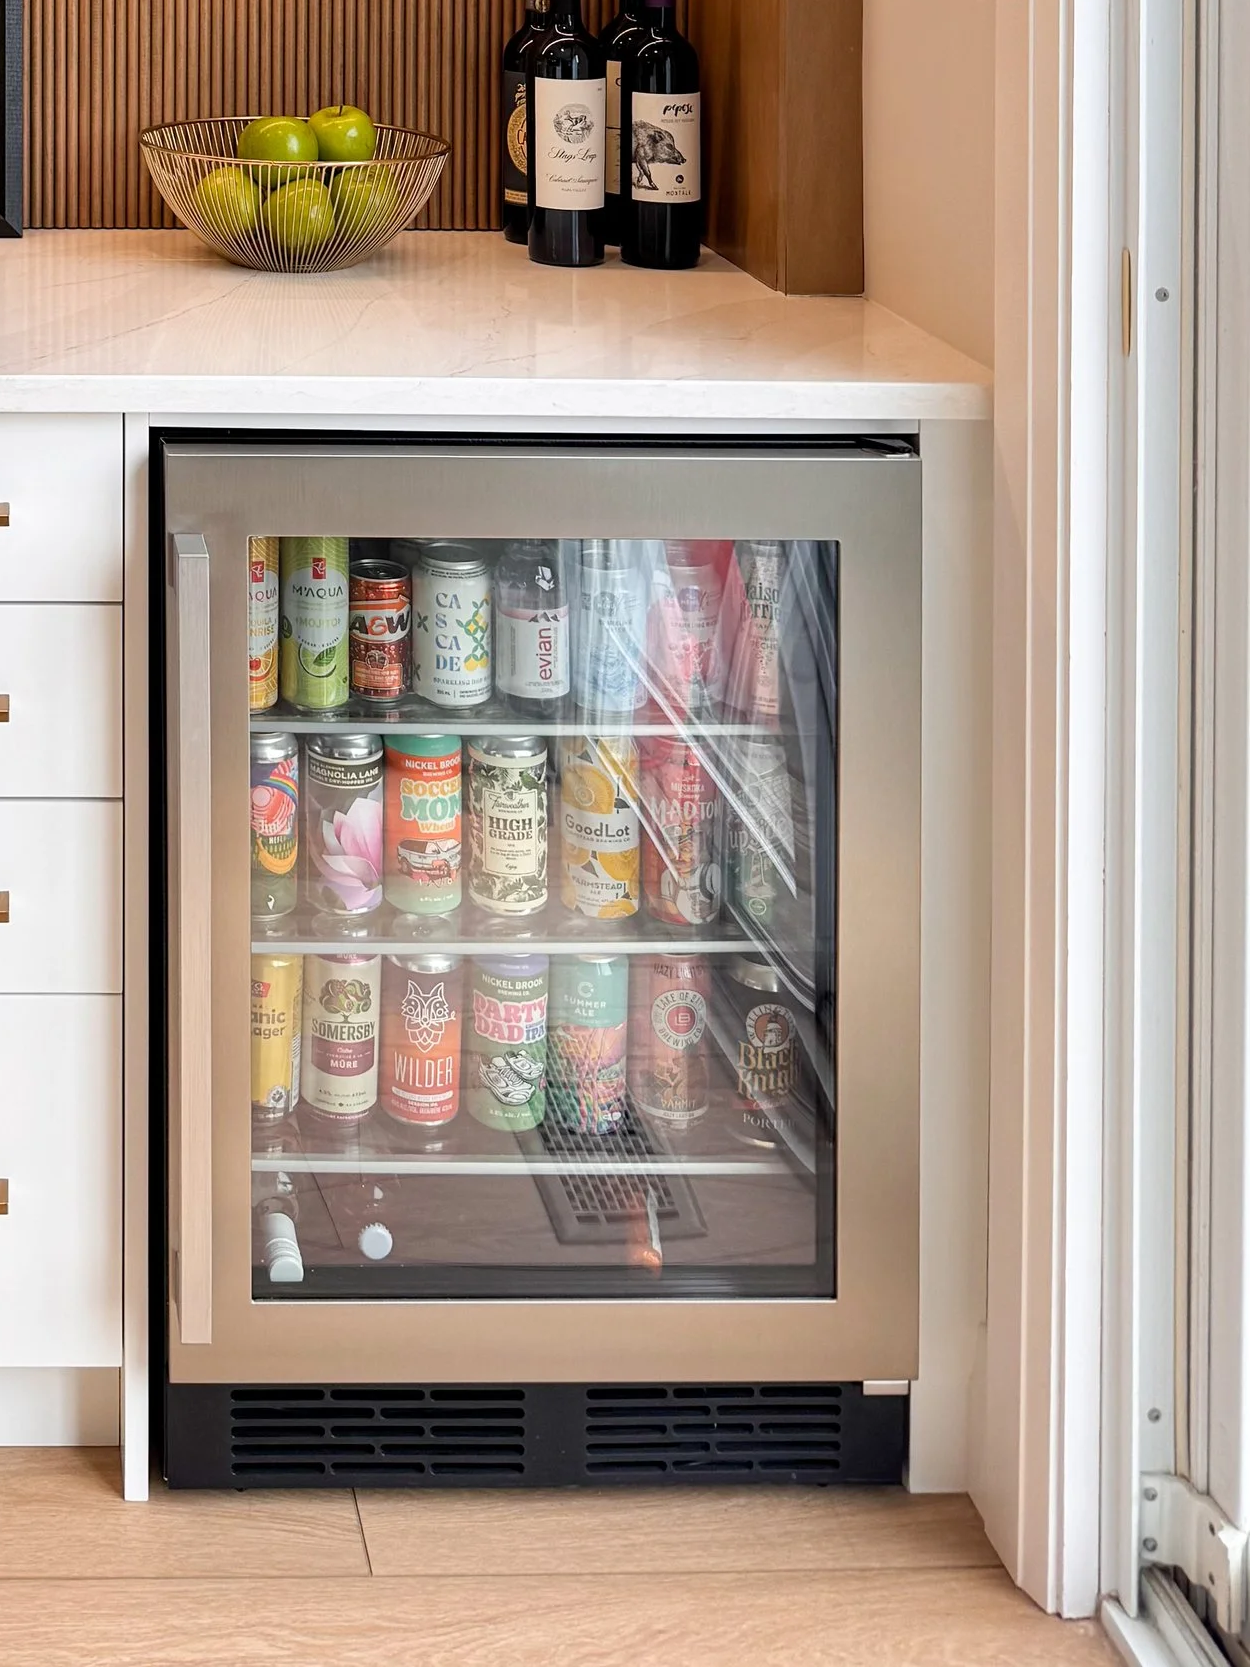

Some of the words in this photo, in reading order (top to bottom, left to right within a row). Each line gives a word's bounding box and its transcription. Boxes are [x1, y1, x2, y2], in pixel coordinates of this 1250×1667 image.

[435, 592, 462, 610] CA
[350, 611, 410, 636] A&W
[435, 612, 448, 629] S
[250, 624, 275, 637] NRISE
[435, 634, 462, 651] CA
[536, 627, 553, 681] evian
[435, 654, 461, 672] DE
[310, 764, 358, 780] MAGNOLIA
[359, 766, 379, 778] LANE
[405, 759, 438, 770] NICKEL
[488, 815, 533, 831] HIGH
[565, 814, 630, 838] GoodLot
[488, 829, 533, 841] GRADE
[572, 875, 623, 890] FARMSTEAD
[482, 973, 514, 990] NICKEL
[515, 976, 543, 990] BROOK
[473, 990, 548, 1023] PARTY
[563, 994, 607, 1009] SUMMER
[251, 1009, 287, 1024] anic
[574, 1008, 595, 1017] ALE
[253, 1025, 288, 1040] ager
[311, 1018, 375, 1041] SOMERSBY
[474, 1014, 524, 1043] DAD
[525, 1025, 545, 1042] IPA
[394, 1050, 453, 1088] WILDER
